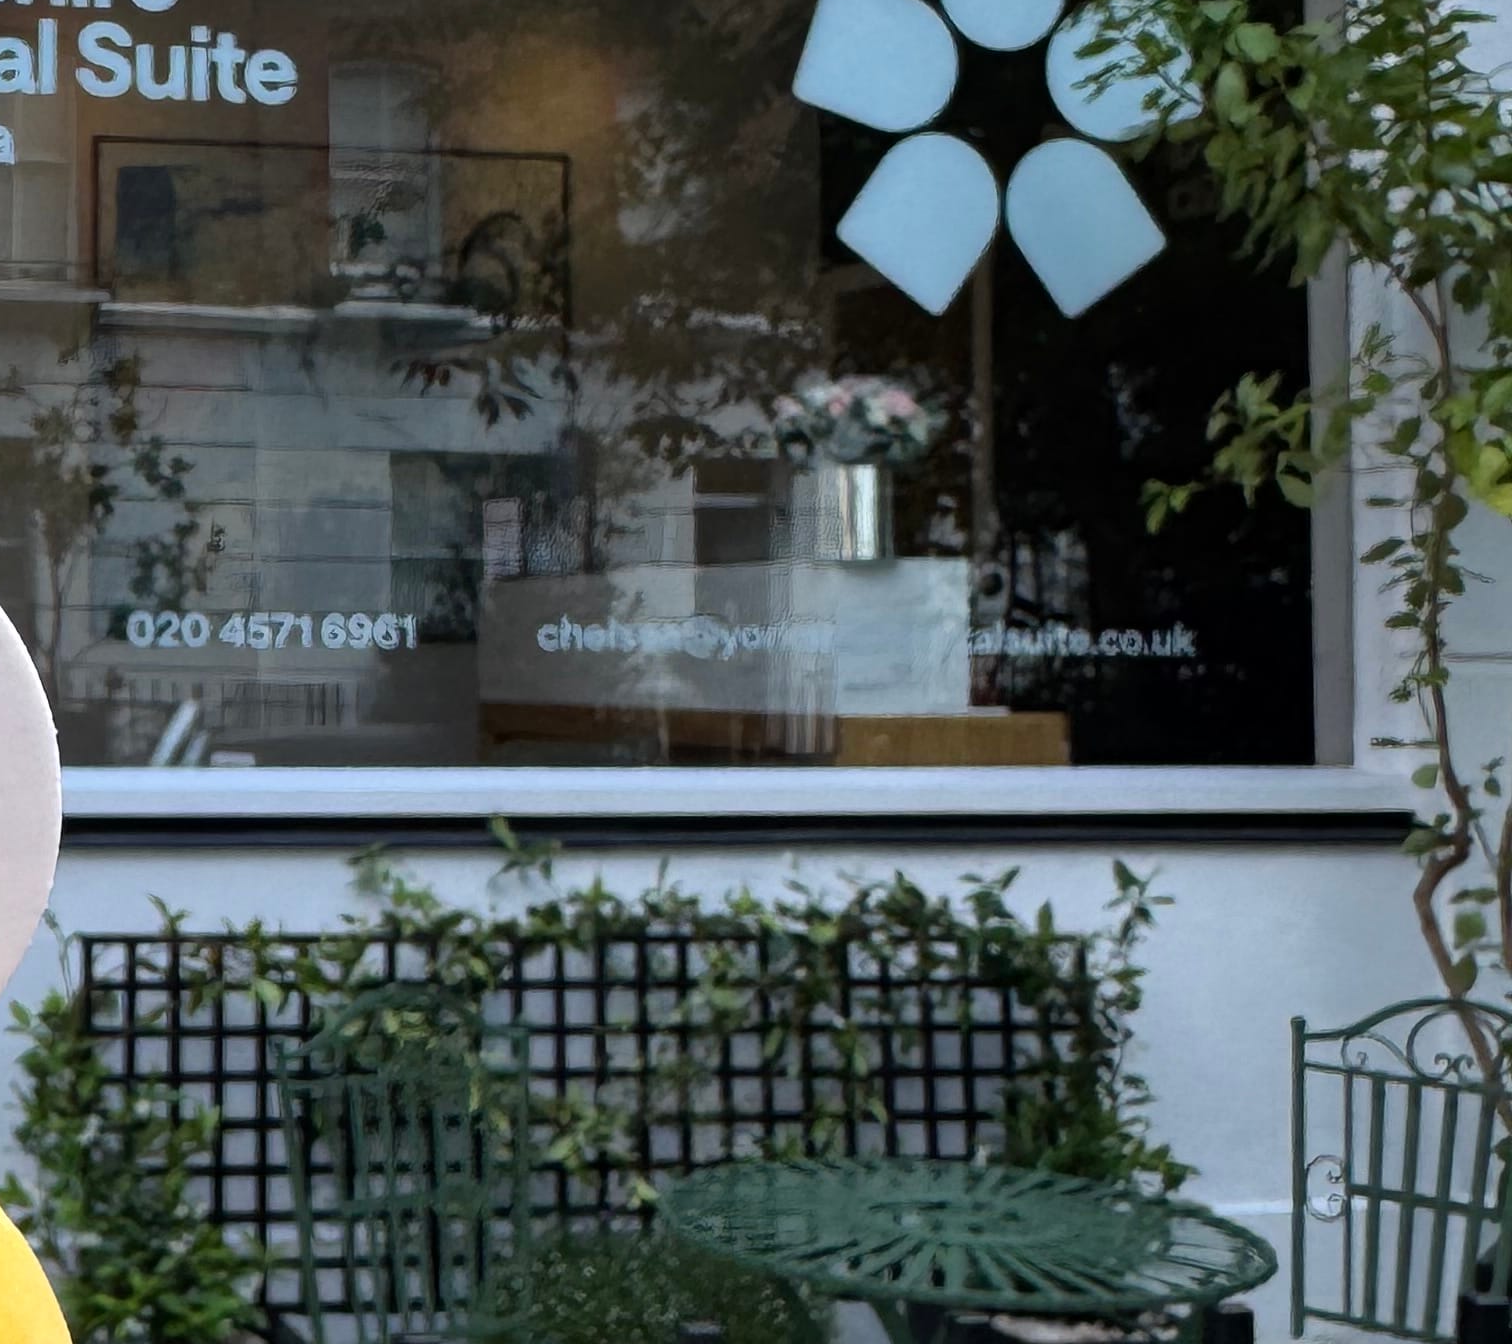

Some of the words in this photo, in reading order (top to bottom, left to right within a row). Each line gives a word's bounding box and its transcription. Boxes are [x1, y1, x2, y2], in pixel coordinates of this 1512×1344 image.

[75, 23, 298, 105] Suite
[126, 610, 211, 649] 020
[219, 611, 313, 650] 4571
